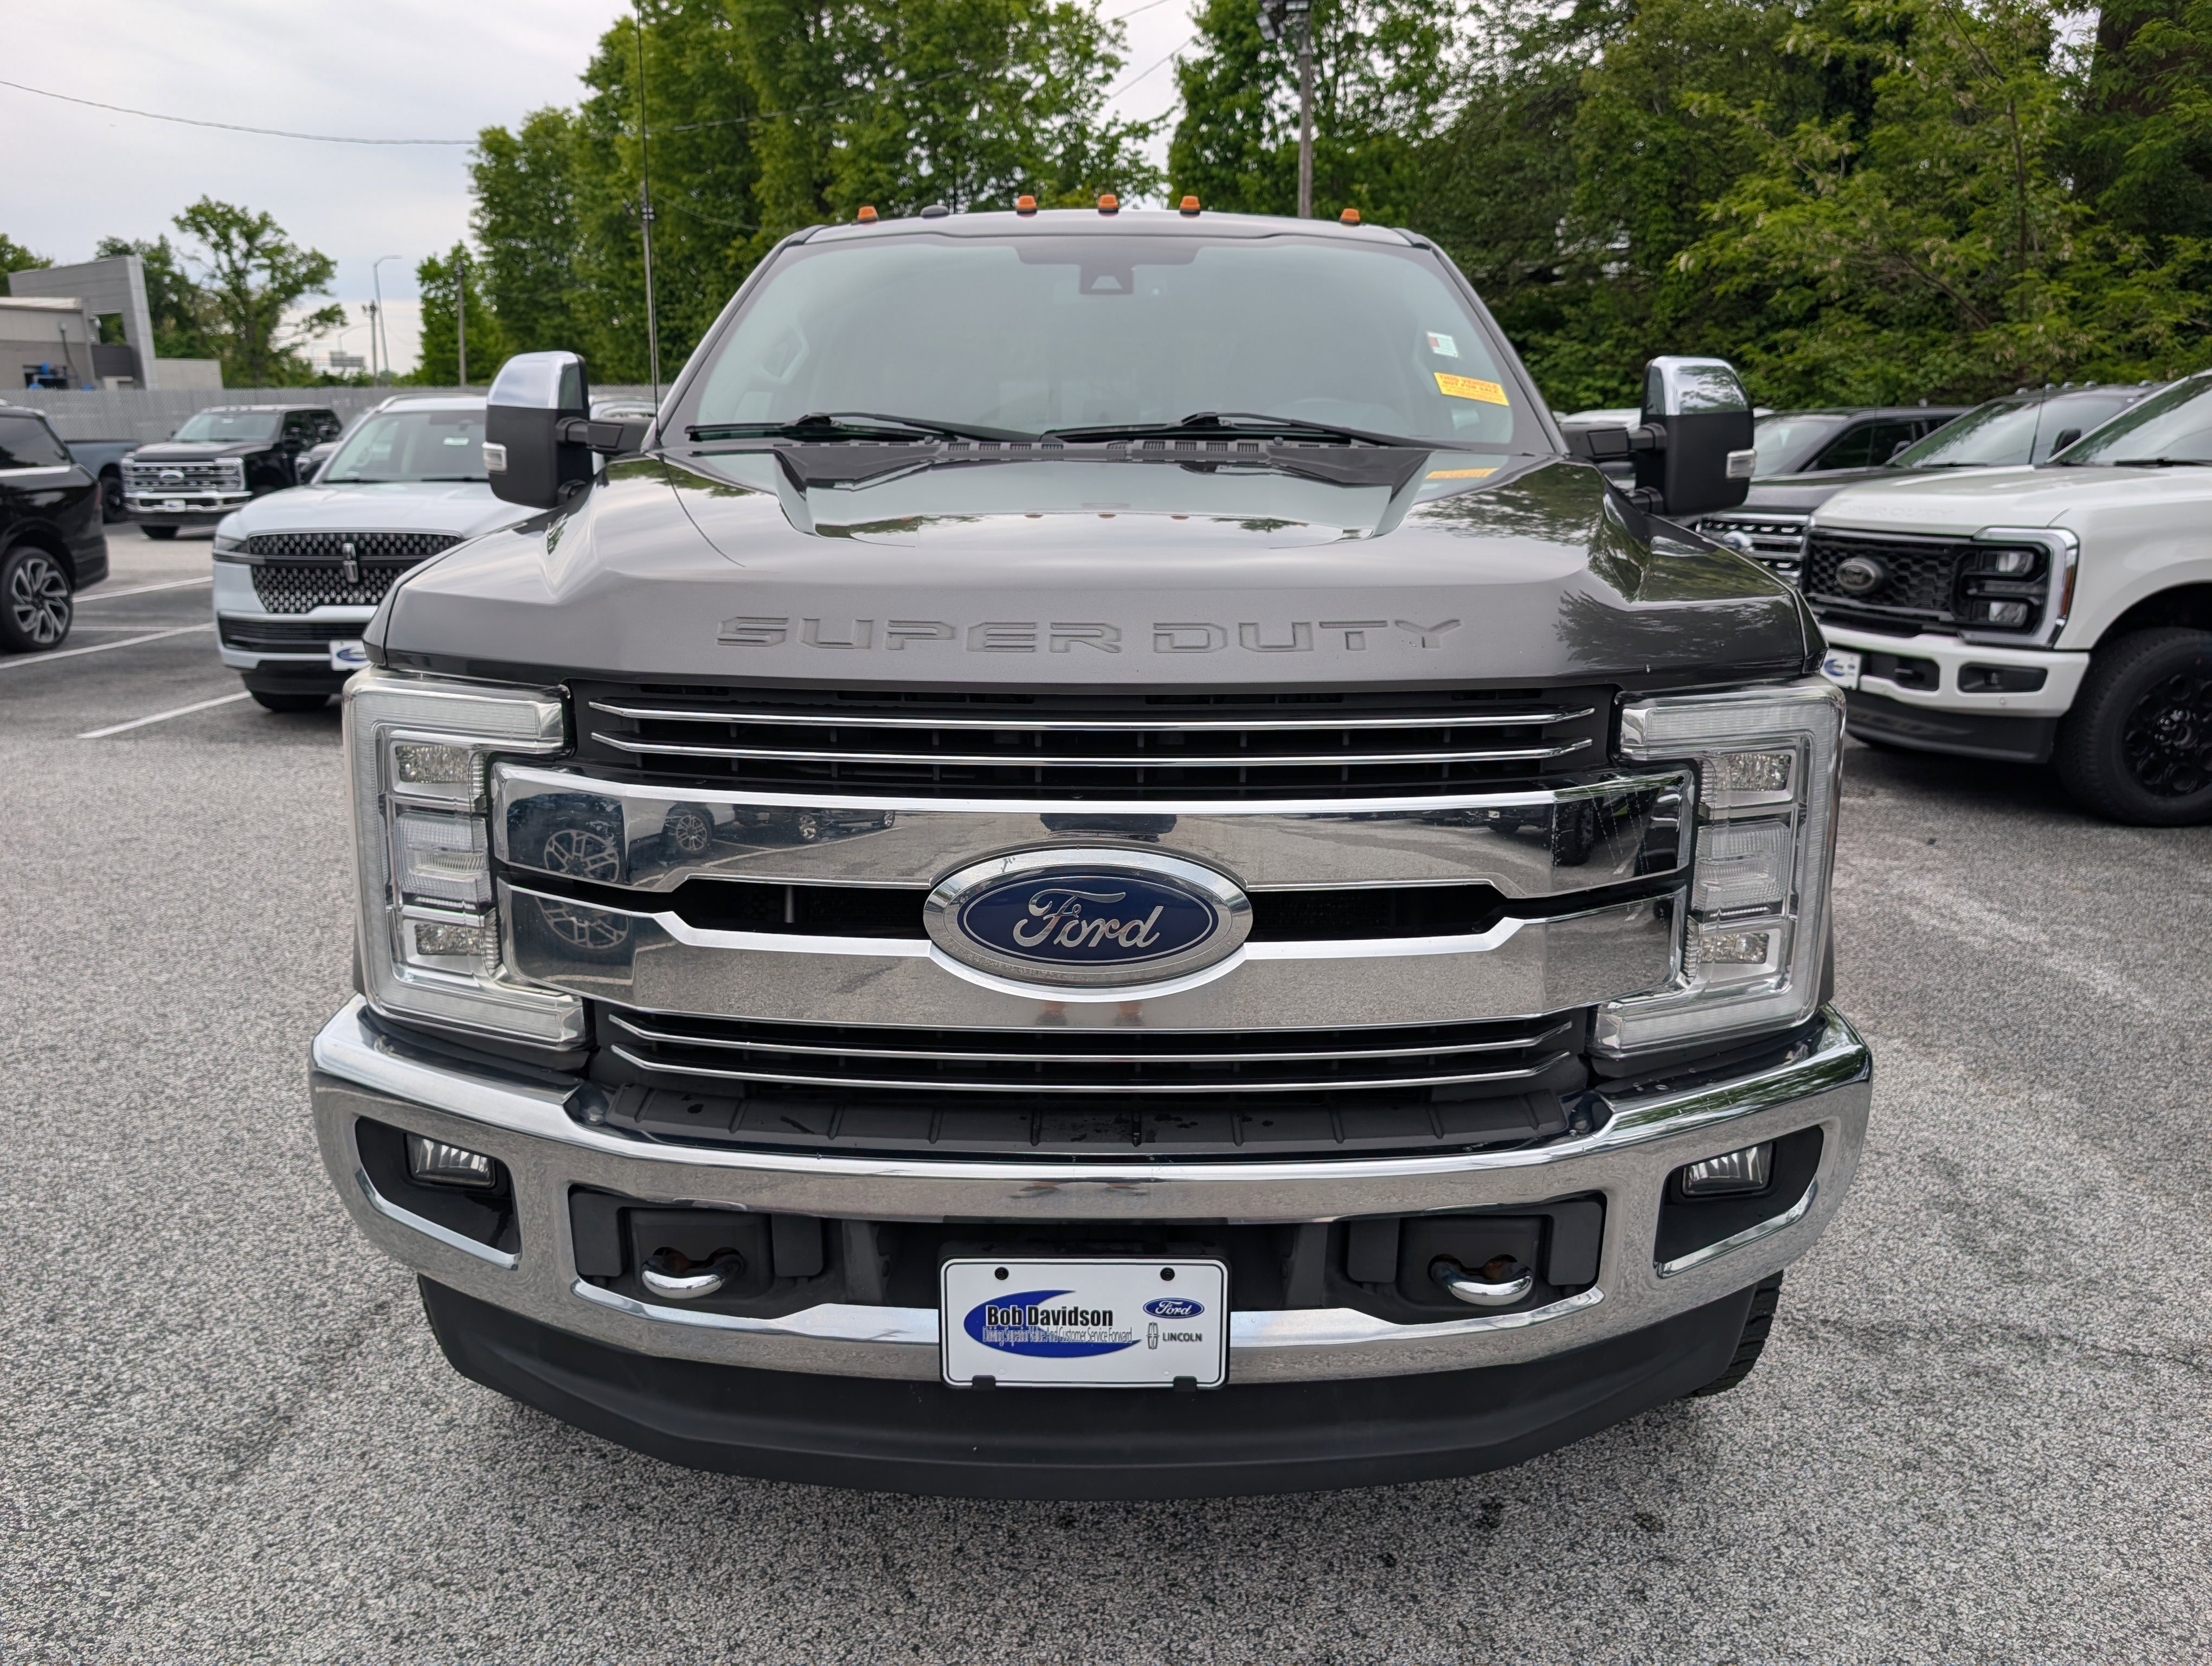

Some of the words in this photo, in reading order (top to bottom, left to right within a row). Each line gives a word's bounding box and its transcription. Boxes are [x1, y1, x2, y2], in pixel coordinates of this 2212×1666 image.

[717, 617, 1122, 653] SUPER
[1153, 619, 1461, 653] DUTY
[1013, 888, 1164, 948] Ford
[986, 1305, 1023, 1326] Bob
[1027, 1305, 1114, 1327] Davidson
[1155, 1300, 1193, 1315] Ford
[982, 1326, 1004, 1346] Driving
[1046, 1326, 1058, 1342] And
[1058, 1327, 1086, 1342] Customer
[1087, 1327, 1108, 1342] Service
[1108, 1327, 1133, 1342] Forward
[1162, 1332, 1203, 1342] LINCOLN
